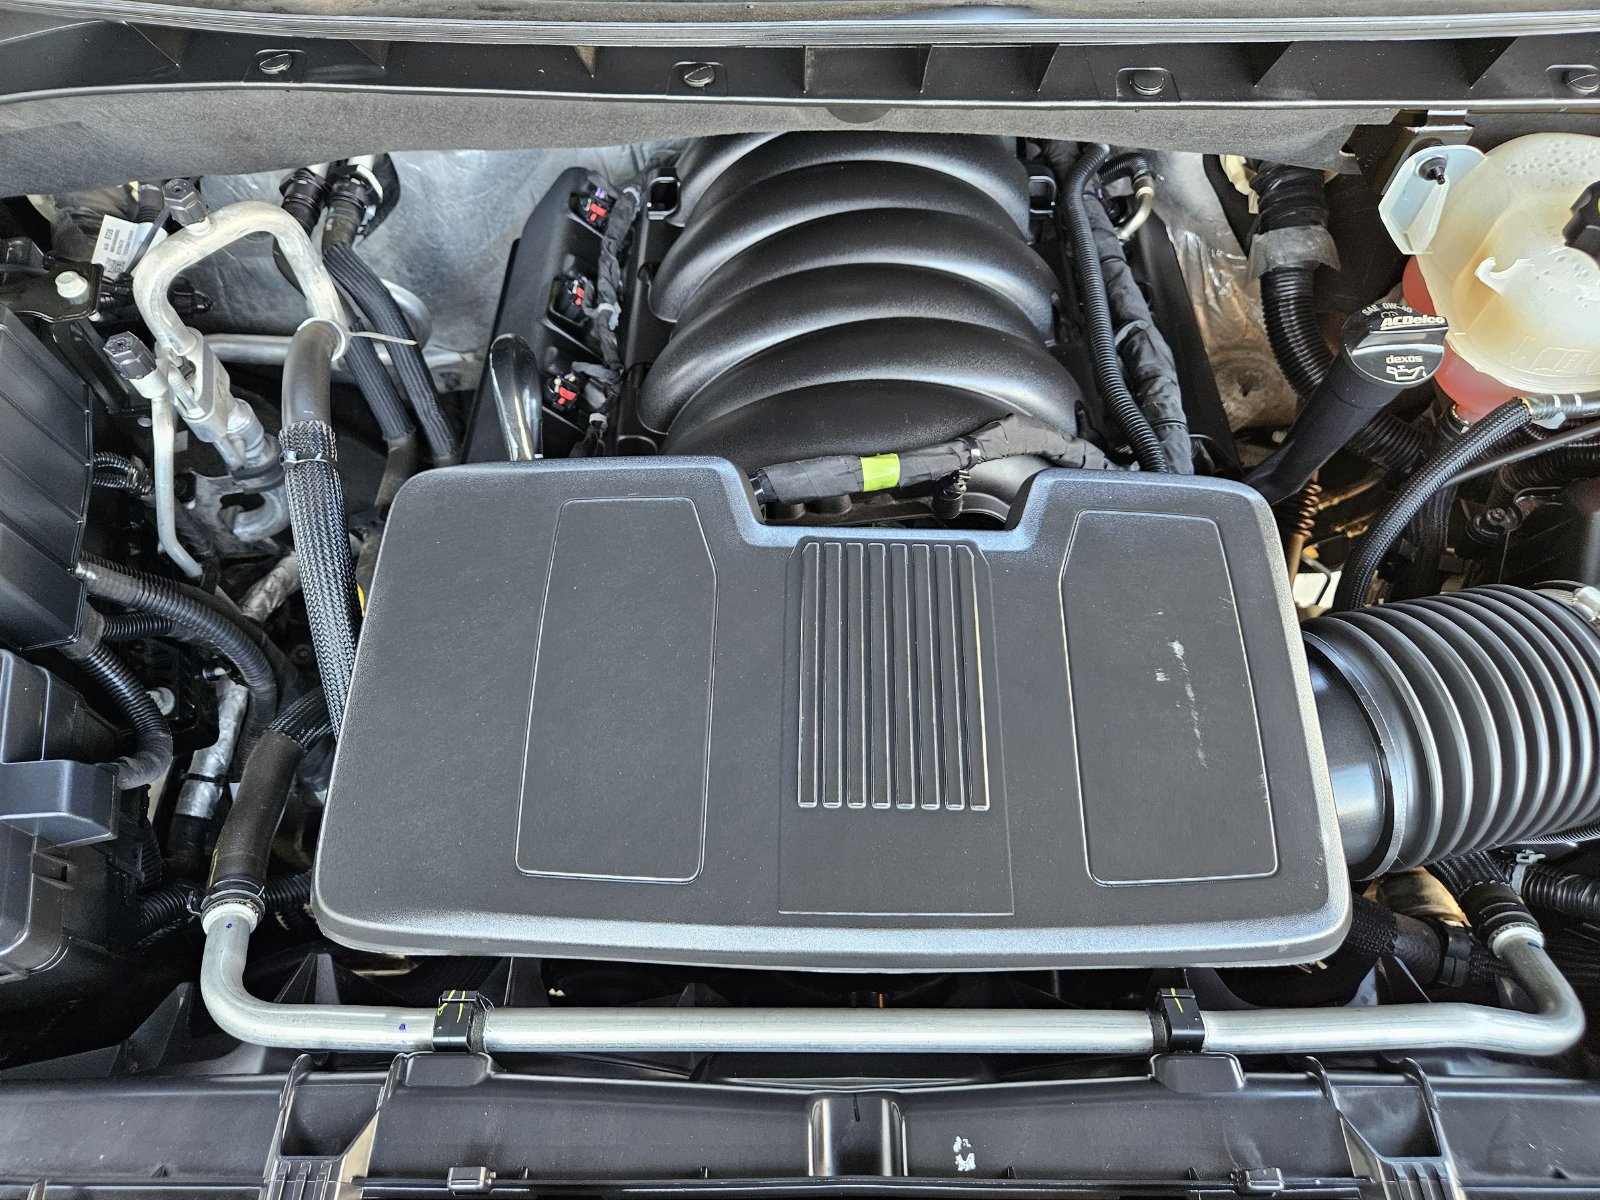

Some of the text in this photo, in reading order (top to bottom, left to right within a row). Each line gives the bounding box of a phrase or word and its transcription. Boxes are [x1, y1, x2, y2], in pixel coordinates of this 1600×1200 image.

[1361, 304, 1380, 316] SAE
[1380, 314, 1445, 330] ACDelco
[1385, 355, 1423, 364] dexos
